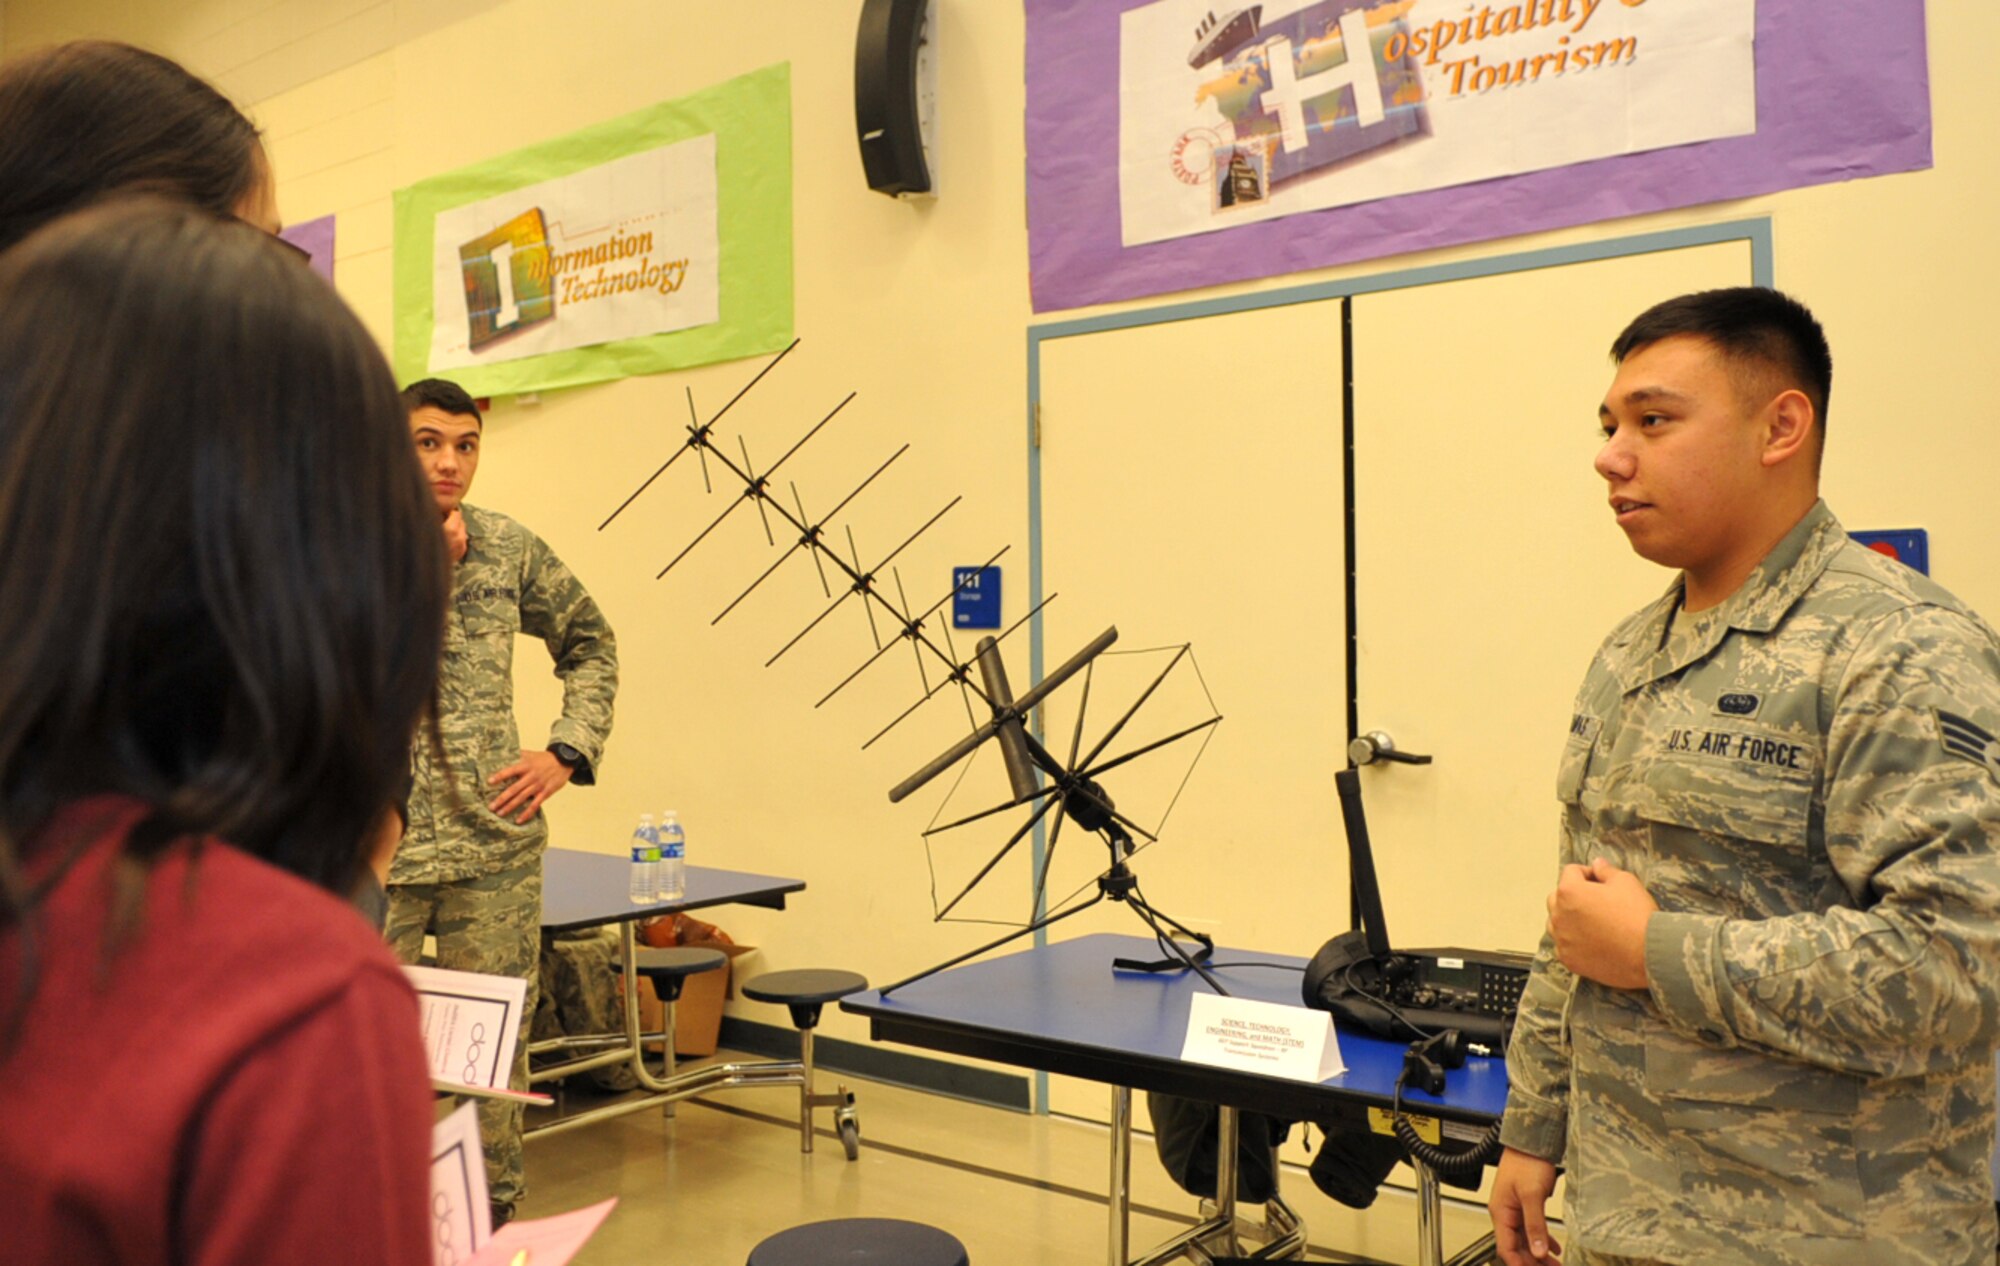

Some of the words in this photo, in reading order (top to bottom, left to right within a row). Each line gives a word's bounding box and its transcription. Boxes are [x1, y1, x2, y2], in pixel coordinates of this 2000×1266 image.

[1442, 35, 1638, 96] Tourism
[561, 256, 690, 306] Technology
[1668, 729, 1692, 753] U.S.
[1699, 731, 1731, 757] AIR
[1738, 736, 1803, 770] FORCE
